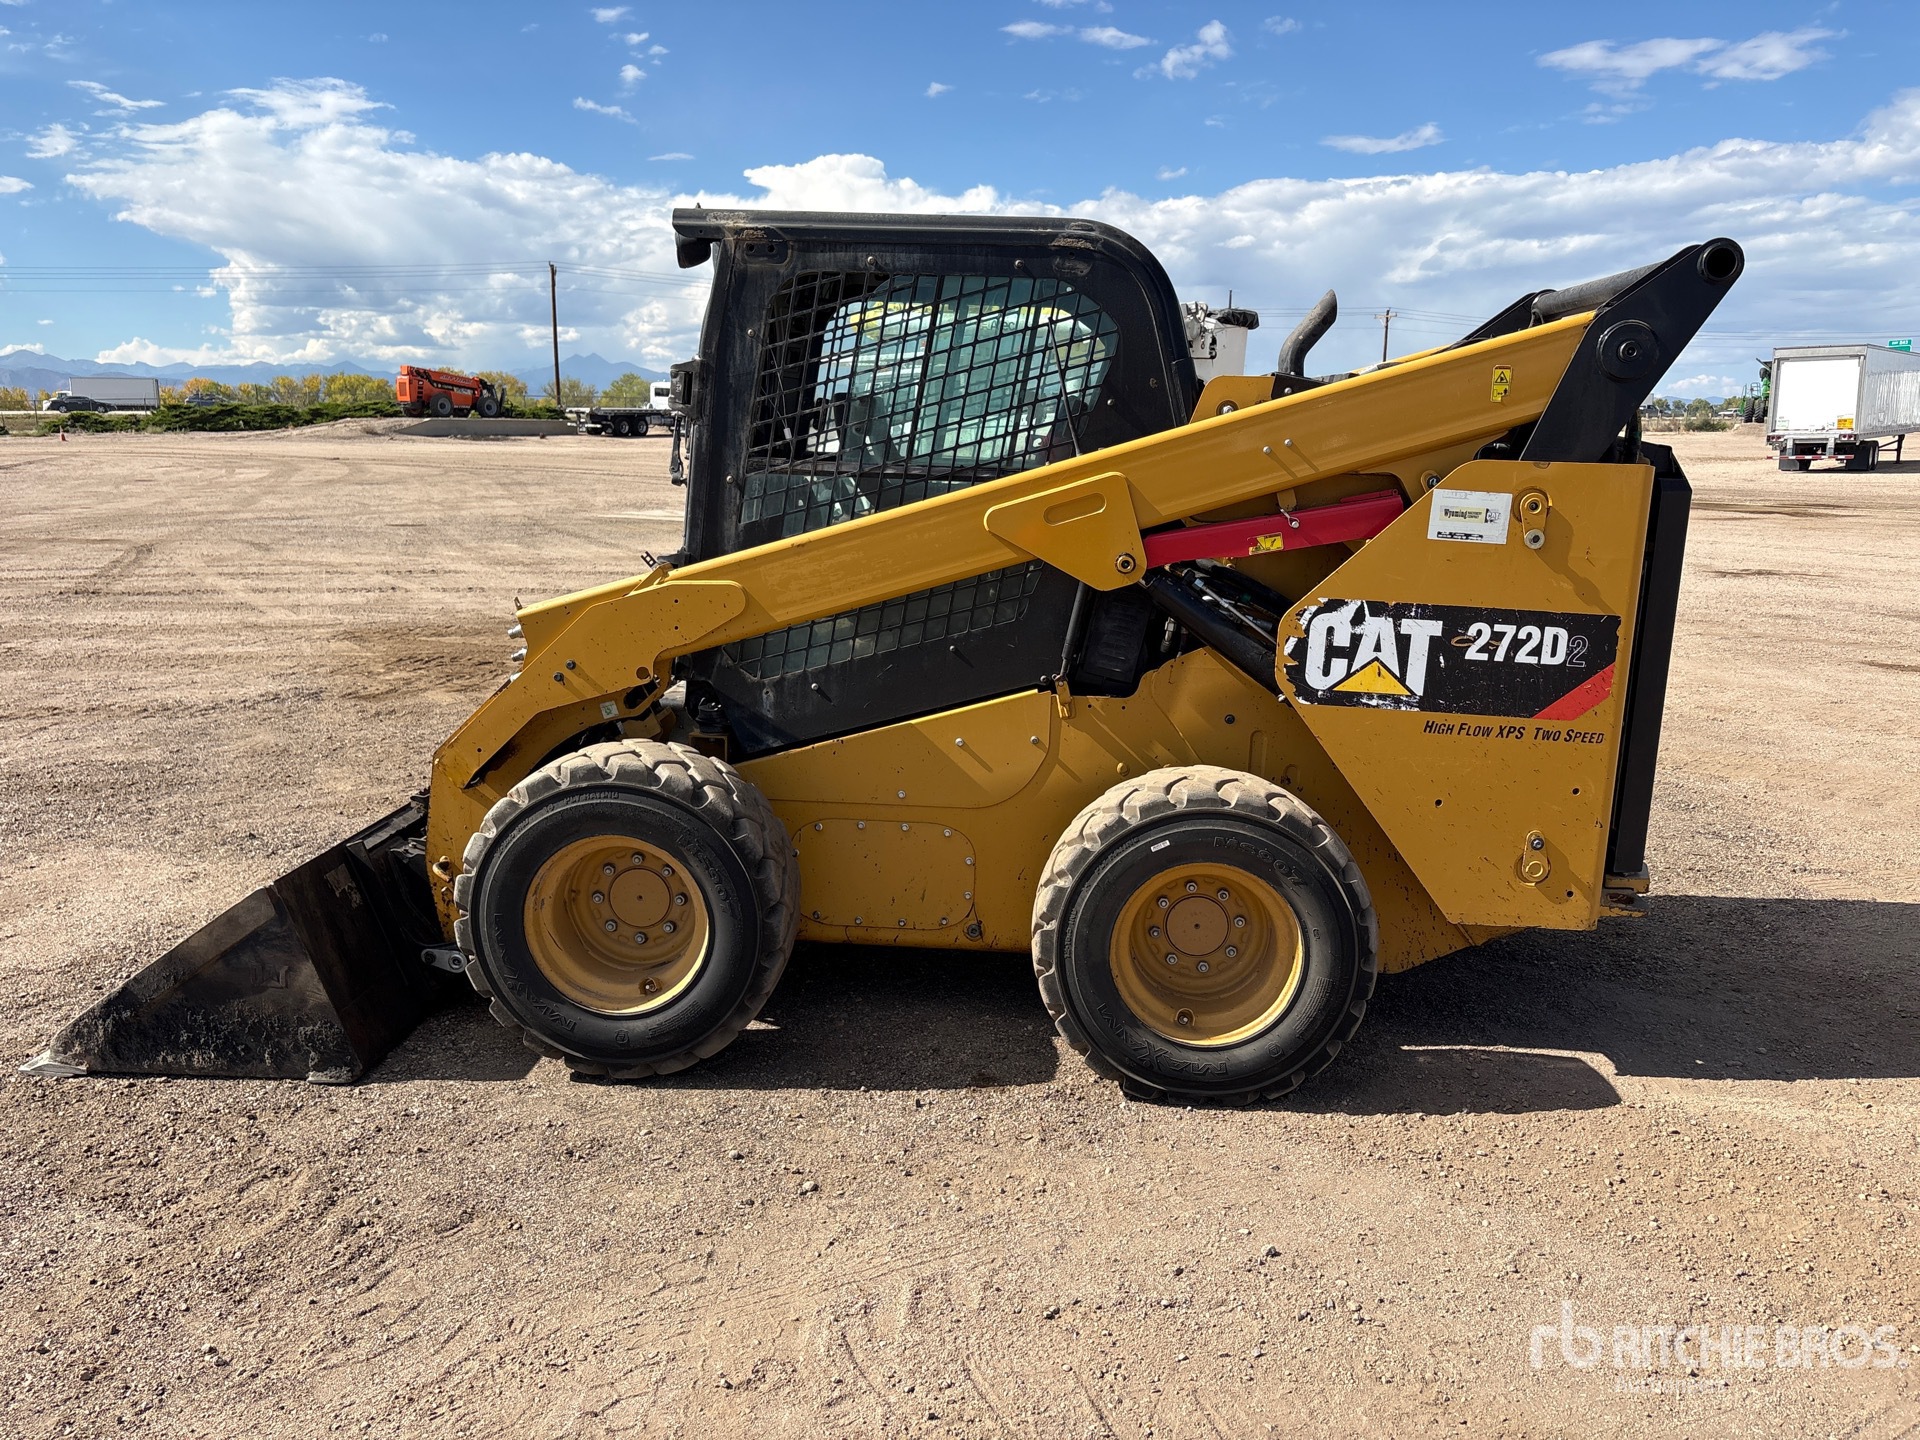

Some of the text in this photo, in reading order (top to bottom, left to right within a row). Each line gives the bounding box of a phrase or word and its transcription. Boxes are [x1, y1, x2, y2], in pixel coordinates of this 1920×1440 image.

[990, 319, 1016, 331] Aec
[1444, 508, 1468, 519] Wyoming
[1486, 511, 1501, 521] CAT
[1304, 608, 1443, 697] CAT
[1423, 719, 1605, 745] HIGH FLOW XPS TWO SPEED
[1096, 1002, 1229, 1075] MAXAM
